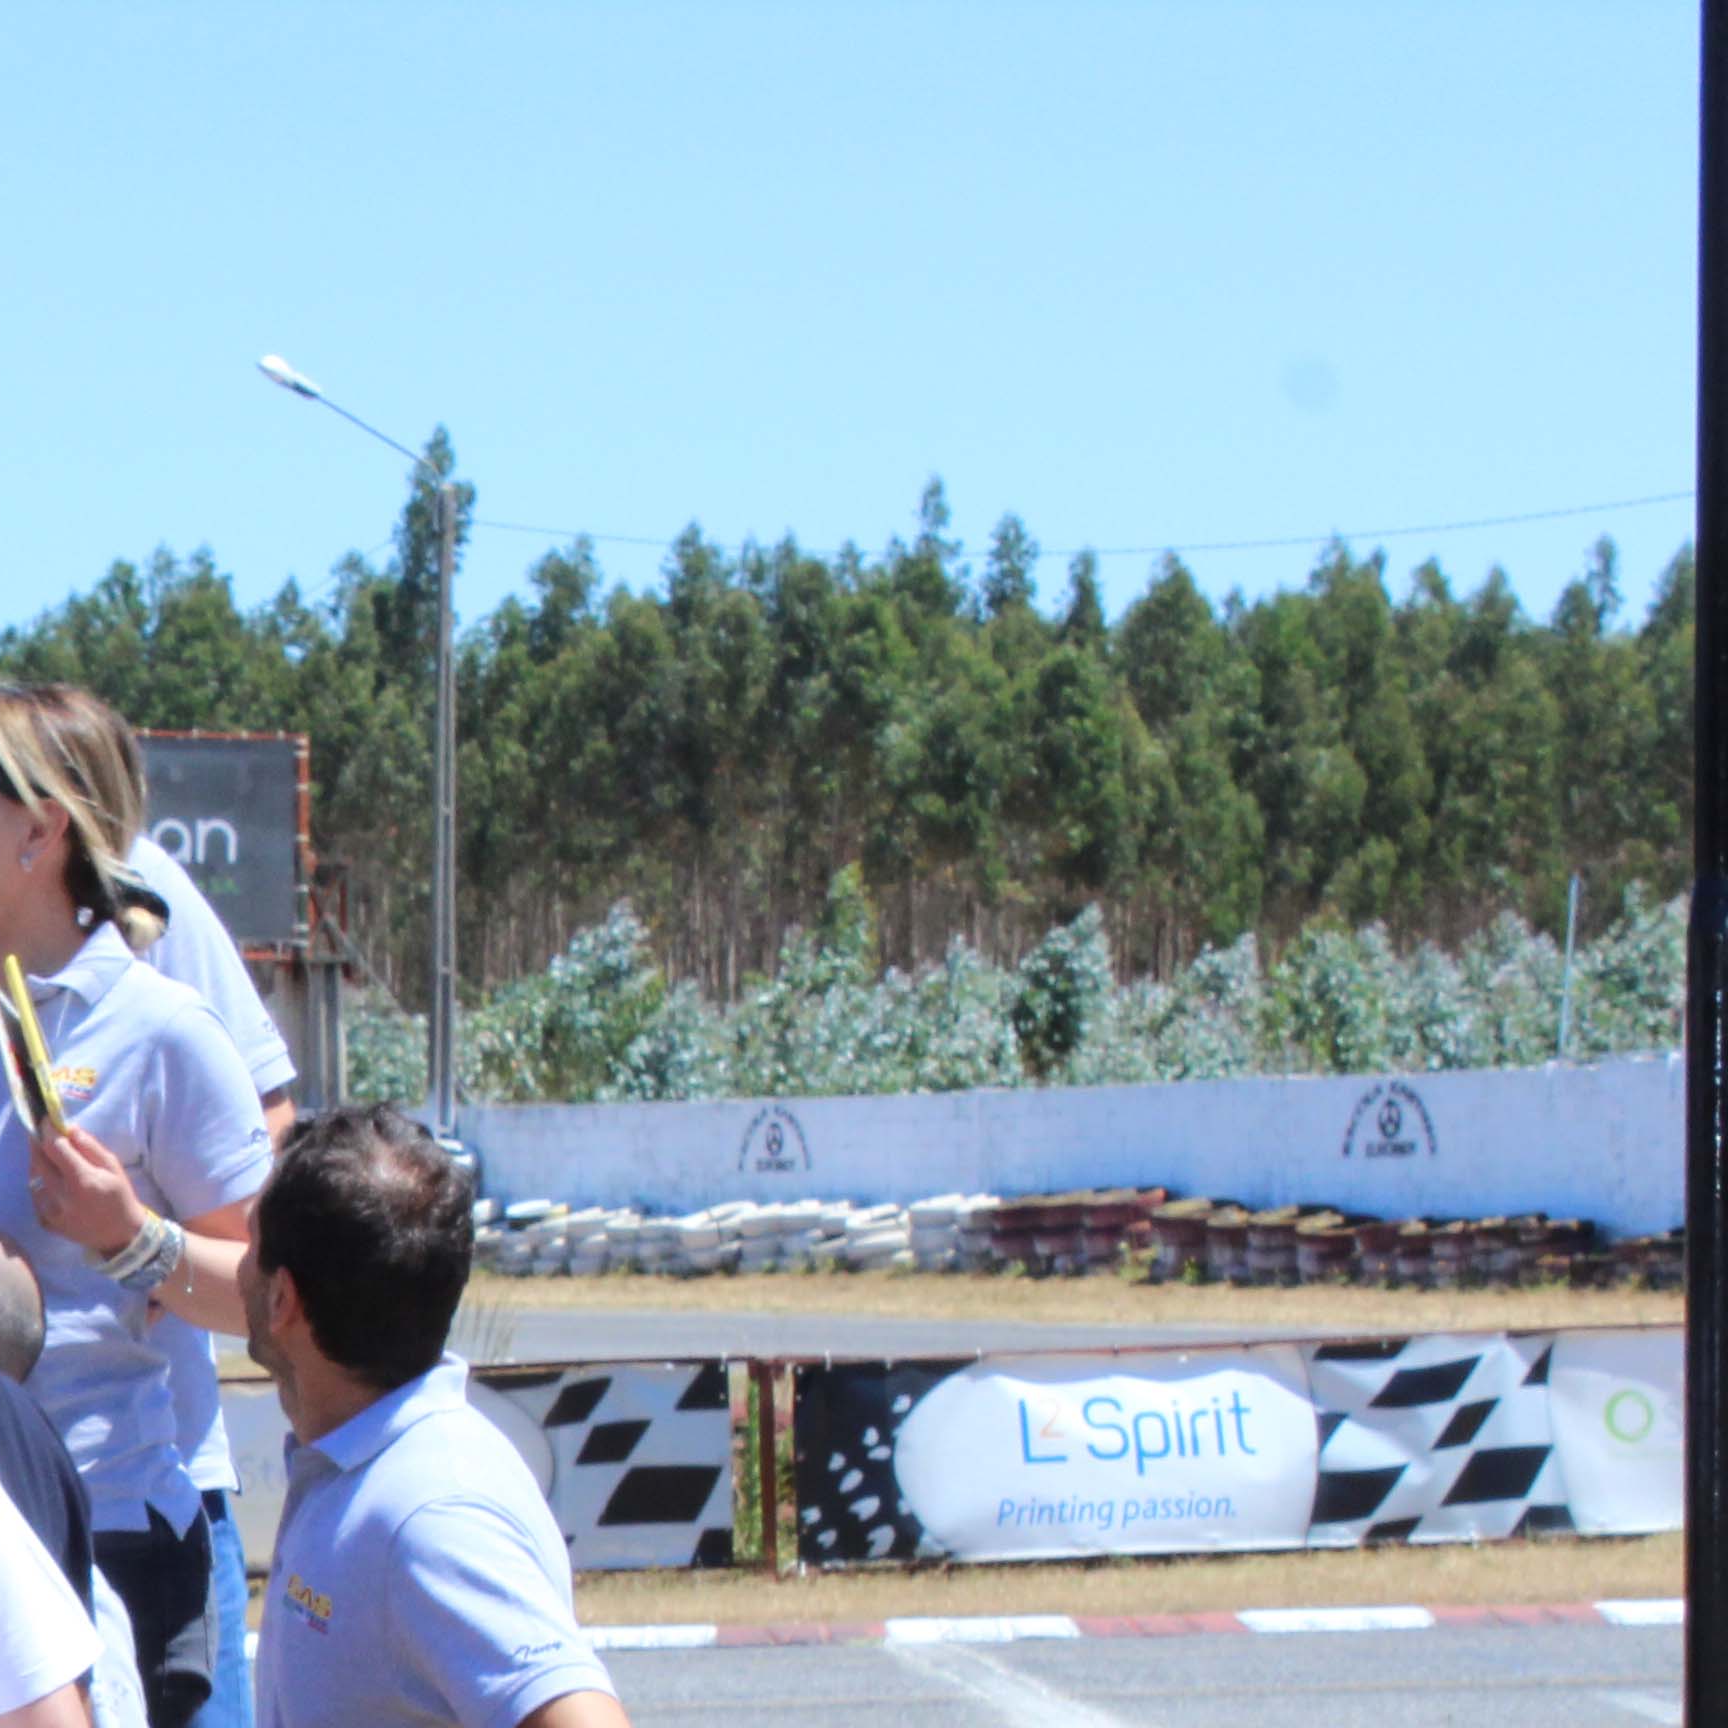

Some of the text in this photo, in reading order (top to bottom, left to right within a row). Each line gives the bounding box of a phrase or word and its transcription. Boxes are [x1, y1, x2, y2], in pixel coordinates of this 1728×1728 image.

[1082, 1390, 1257, 1476] Spirit
[996, 1489, 1238, 1530] Printing passion.
